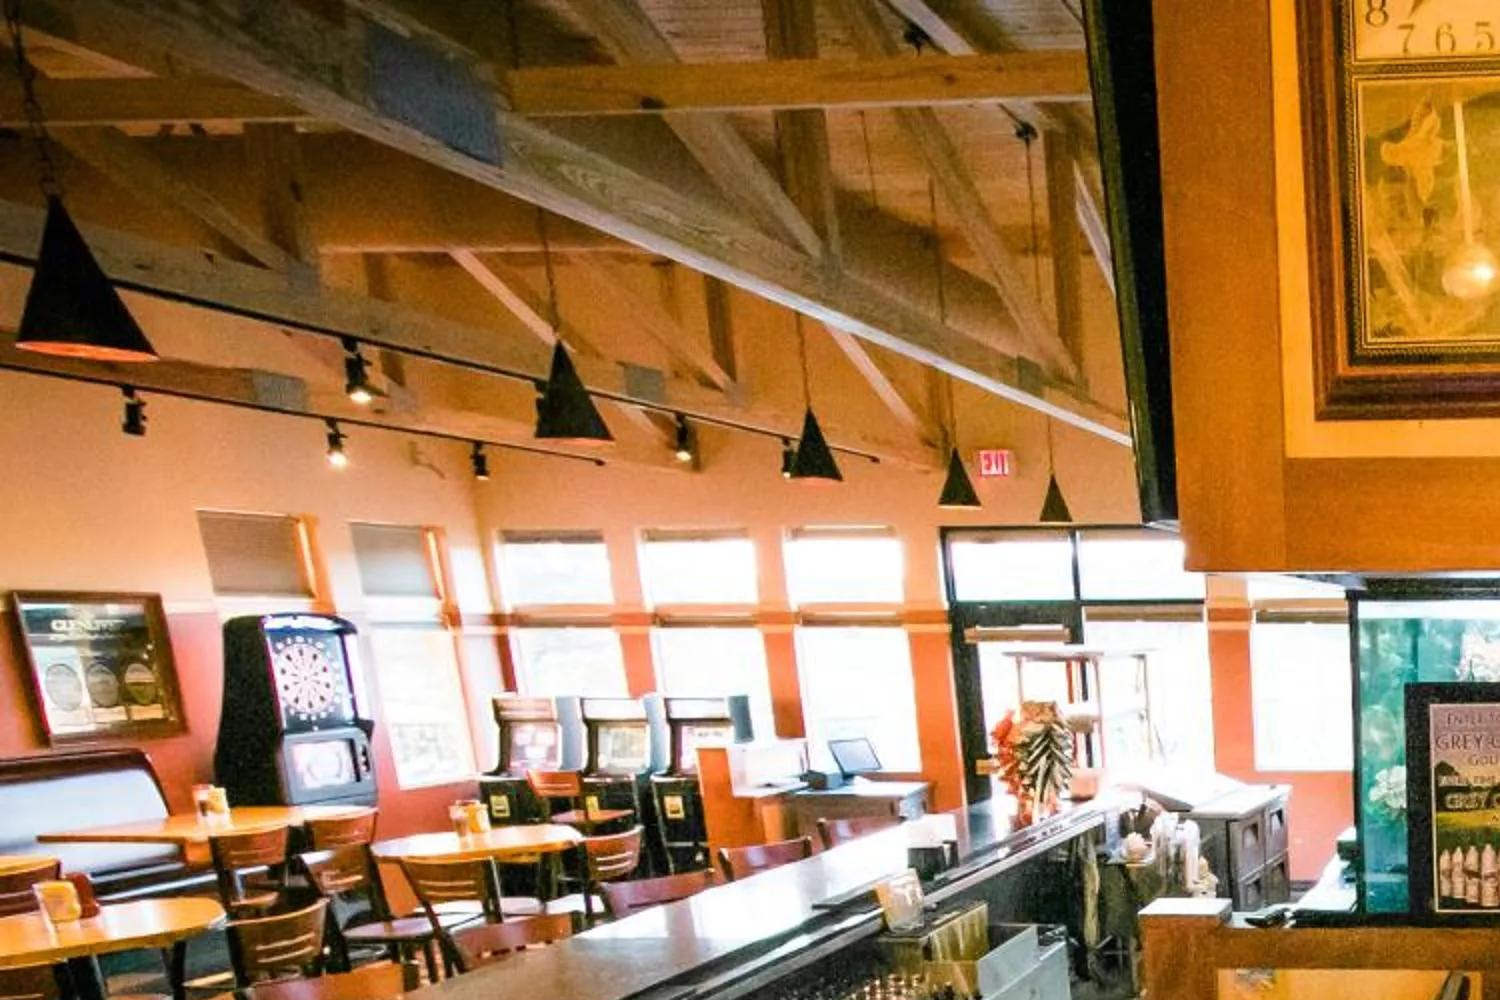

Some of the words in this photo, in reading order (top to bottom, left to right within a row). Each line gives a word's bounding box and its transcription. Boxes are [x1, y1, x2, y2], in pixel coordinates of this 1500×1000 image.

[1397, 23, 1415, 54] 7
[1435, 22, 1456, 53] 6
[1474, 21, 1495, 51] 5
[1435, 734, 1486, 750] GREY
